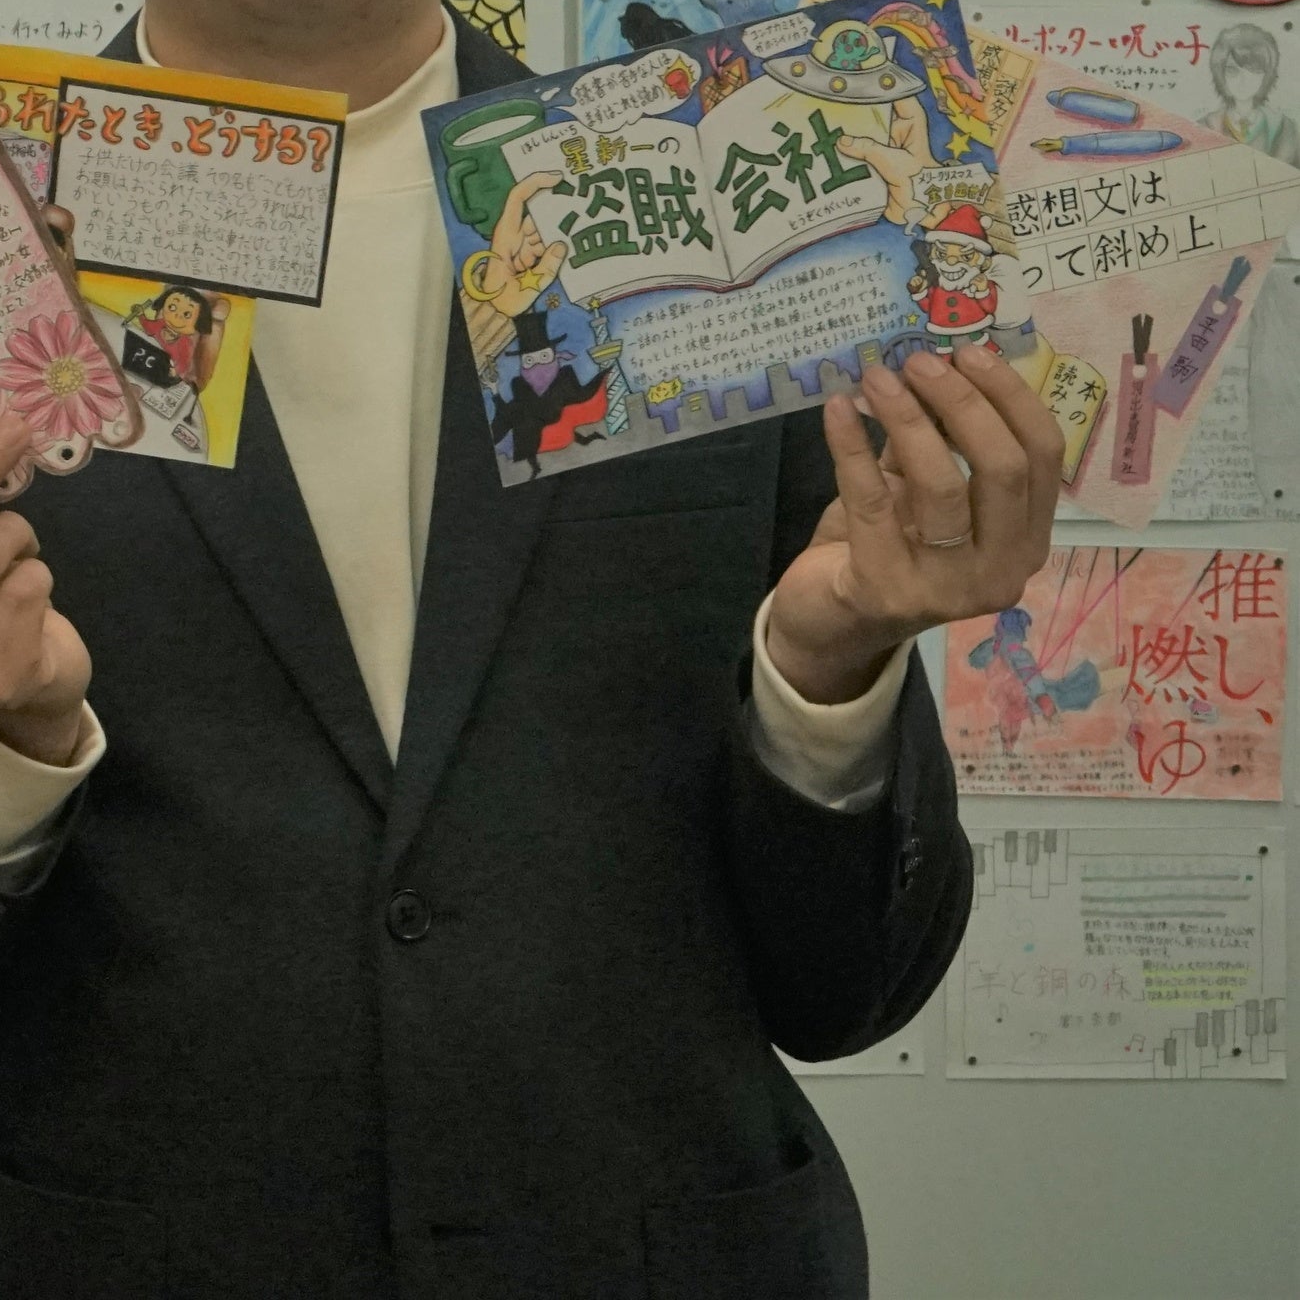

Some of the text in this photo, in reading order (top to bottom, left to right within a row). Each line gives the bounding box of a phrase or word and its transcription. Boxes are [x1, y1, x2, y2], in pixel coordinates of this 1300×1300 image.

[553, 106, 872, 270] 盗賊会社
[558, 134, 682, 175] 星新一の
[1006, 168, 1167, 239] 感想文は
[1020, 214, 1217, 291] って斜め上
[1196, 550, 1281, 726] 推し、
[1119, 621, 1208, 796] 燃ゆ
